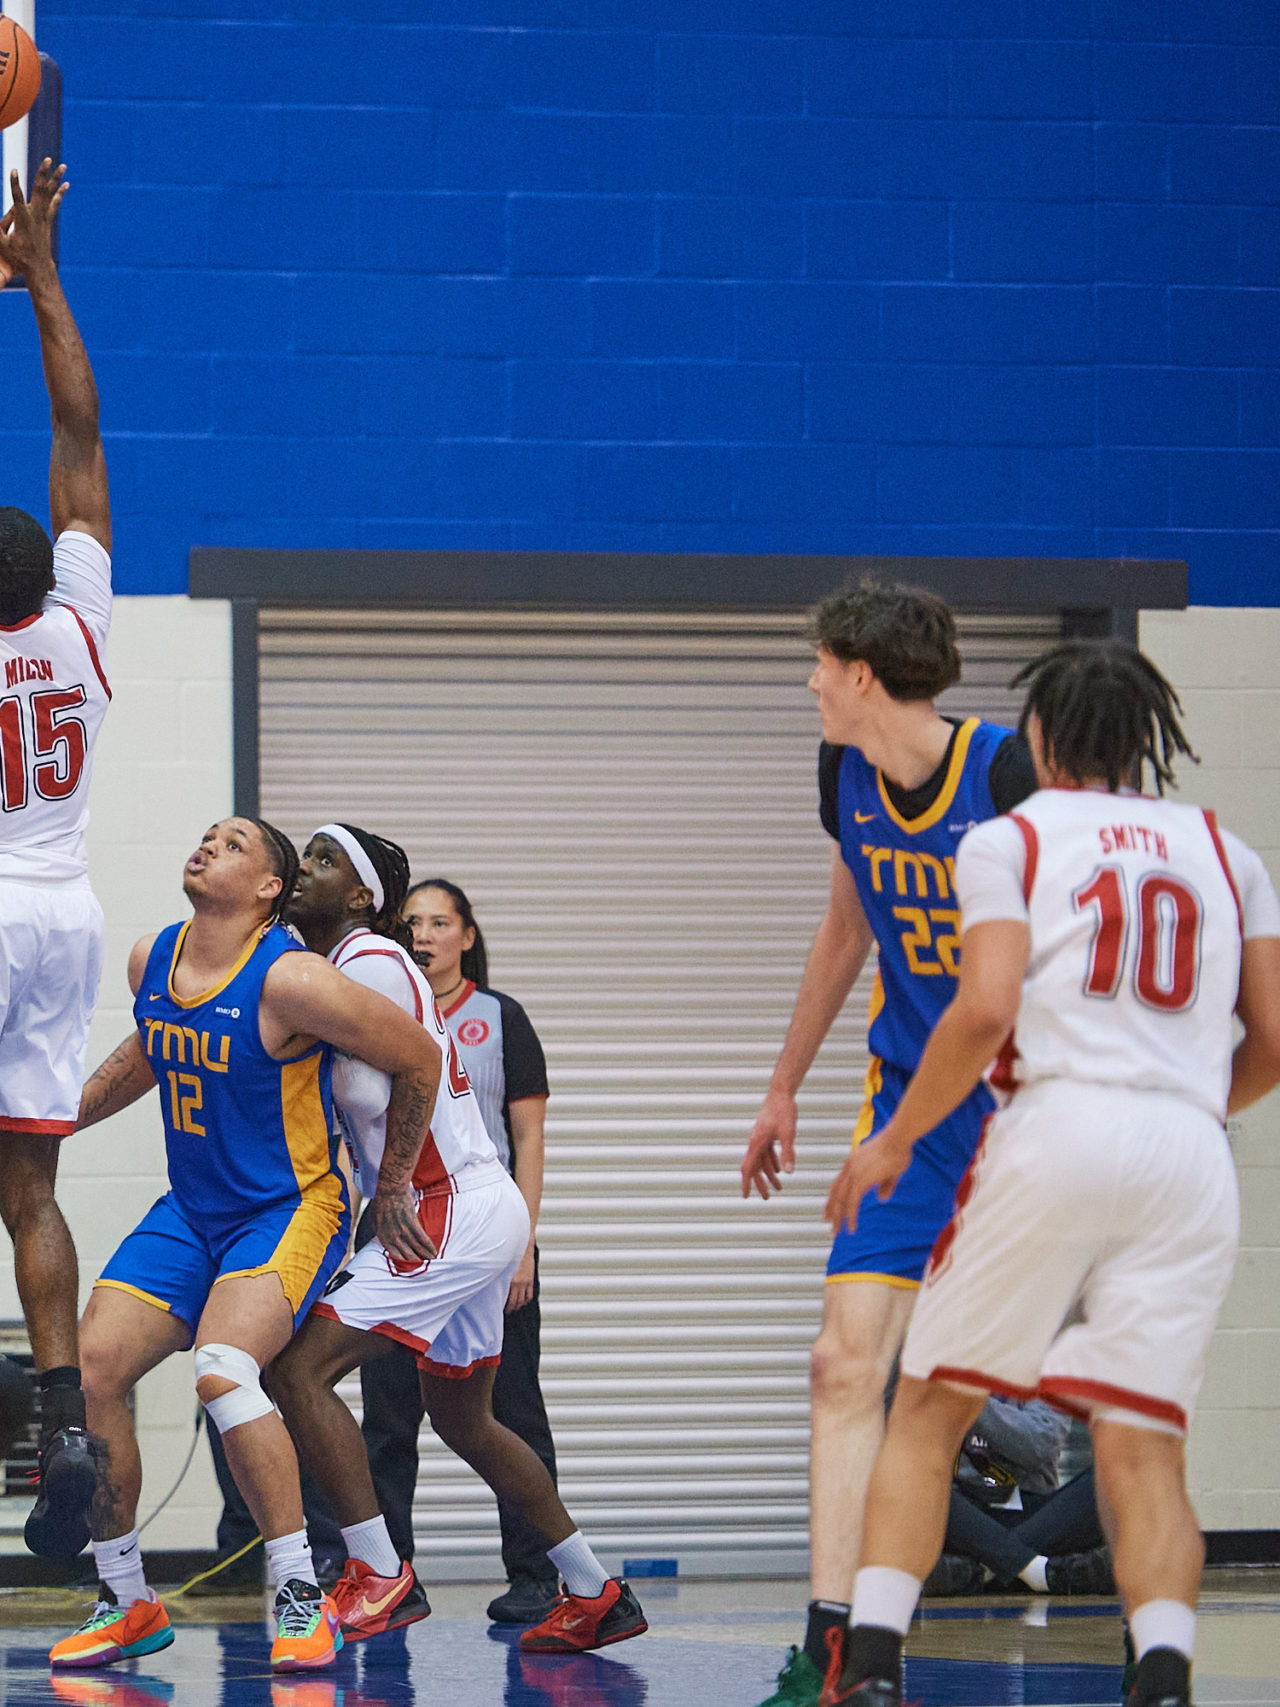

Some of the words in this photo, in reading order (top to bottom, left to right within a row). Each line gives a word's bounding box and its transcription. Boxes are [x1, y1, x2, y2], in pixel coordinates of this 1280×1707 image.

[861, 844, 958, 899] TM
[1099, 824, 1169, 862] SMITH
[893, 906, 960, 978] 22
[1072, 862, 1204, 1014] 10
[144, 1016, 231, 1073] TMU
[167, 1070, 206, 1137] 12
